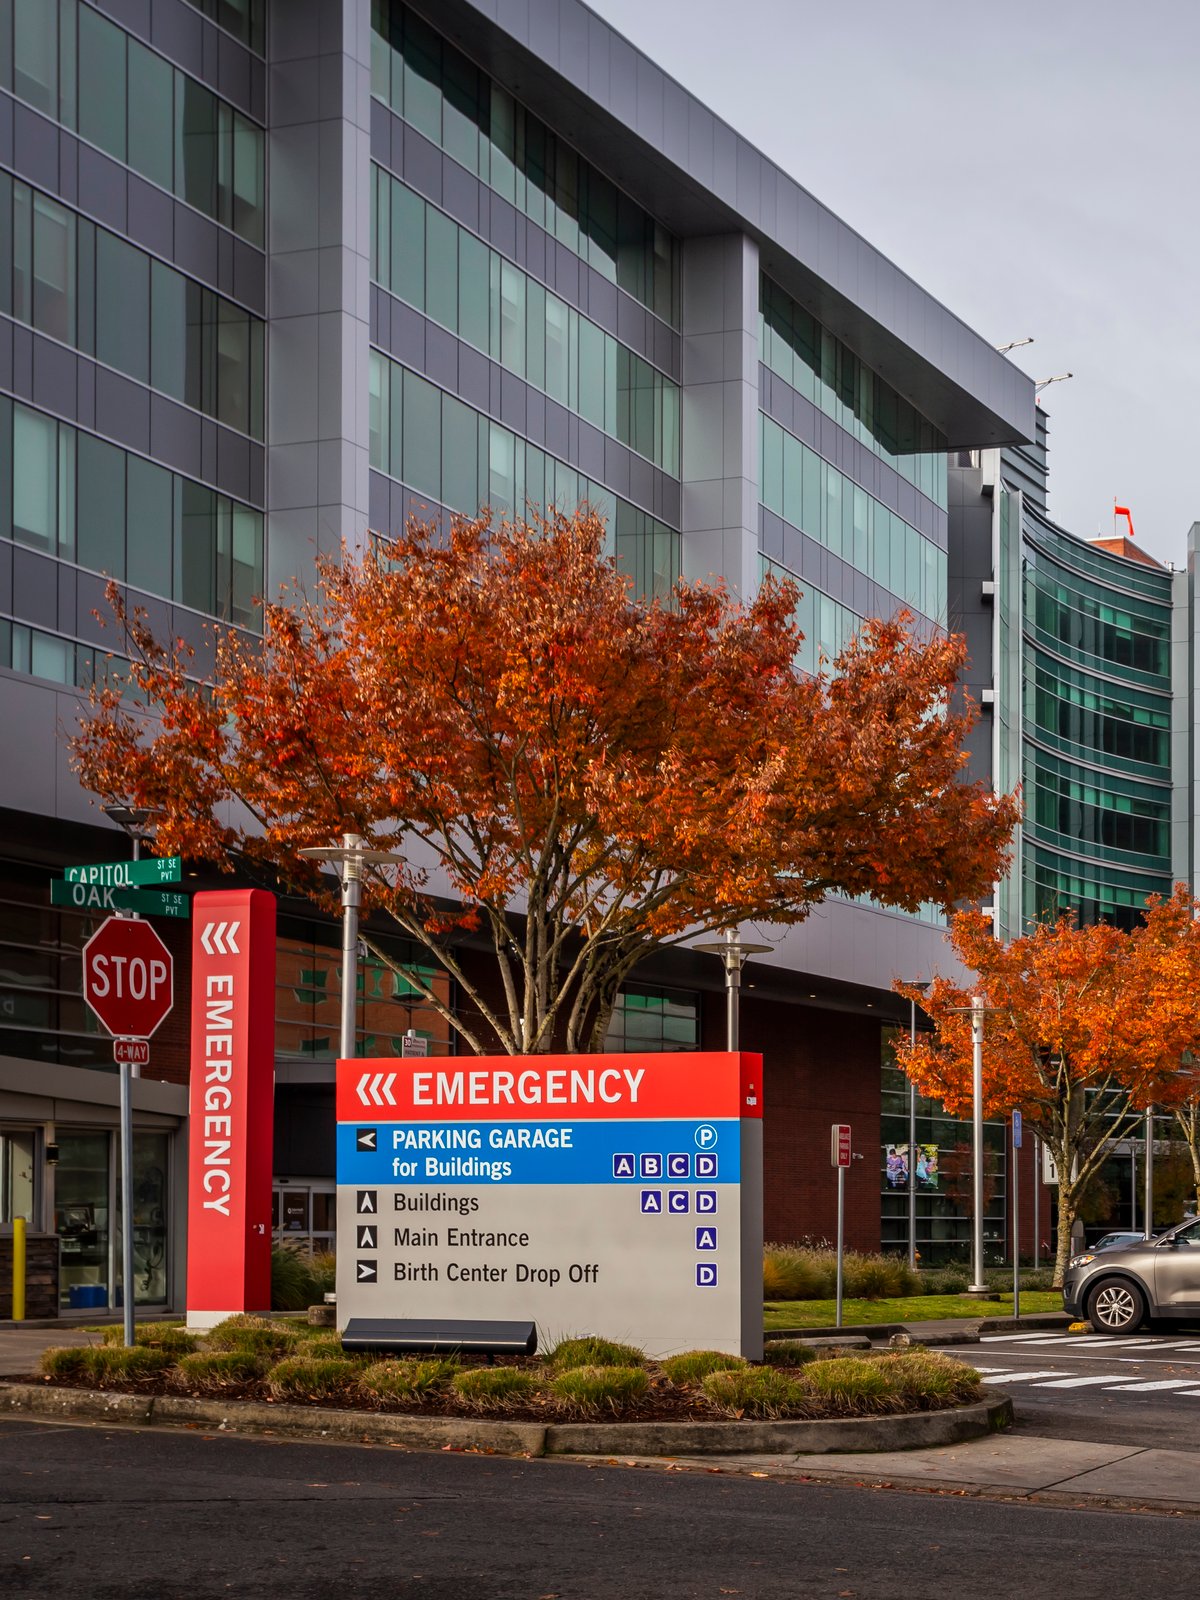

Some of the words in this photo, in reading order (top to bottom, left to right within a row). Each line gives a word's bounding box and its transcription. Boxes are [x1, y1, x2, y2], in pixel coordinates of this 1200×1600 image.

[69, 863, 134, 886] CAPITOL
[157, 859, 166, 870] ST
[167, 858, 177, 869] SE
[160, 870, 173, 881] PVT
[72, 883, 116, 908] OAK
[161, 893, 170, 904] ST
[173, 894, 183, 905] SE
[165, 905, 178, 916] PVT
[91, 953, 168, 1001] STOP
[116, 1044, 148, 1061] 4-WAY
[203, 975, 234, 1217] EMERGENCY
[413, 1068, 646, 1105] EMERGENCY
[393, 1129, 481, 1149] PARKING
[489, 1128, 573, 1149] GARAGE
[700, 1128, 713, 1146] P
[392, 1157, 418, 1177] for
[425, 1156, 512, 1181] Buildings
[617, 1159, 631, 1174] A
[644, 1158, 657, 1174] B
[672, 1158, 685, 1174] C
[700, 1158, 713, 1174] D
[394, 1192, 479, 1216] Buildings
[644, 1195, 658, 1210] A
[672, 1194, 686, 1210] C
[700, 1194, 713, 1210] D
[394, 1227, 438, 1247] Main
[447, 1227, 529, 1247] Entrance
[699, 1231, 714, 1247] A
[394, 1262, 439, 1282] Birth
[446, 1262, 508, 1282] Center
[516, 1263, 561, 1288] Drop
[568, 1263, 599, 1283] Off
[700, 1267, 713, 1283] D
